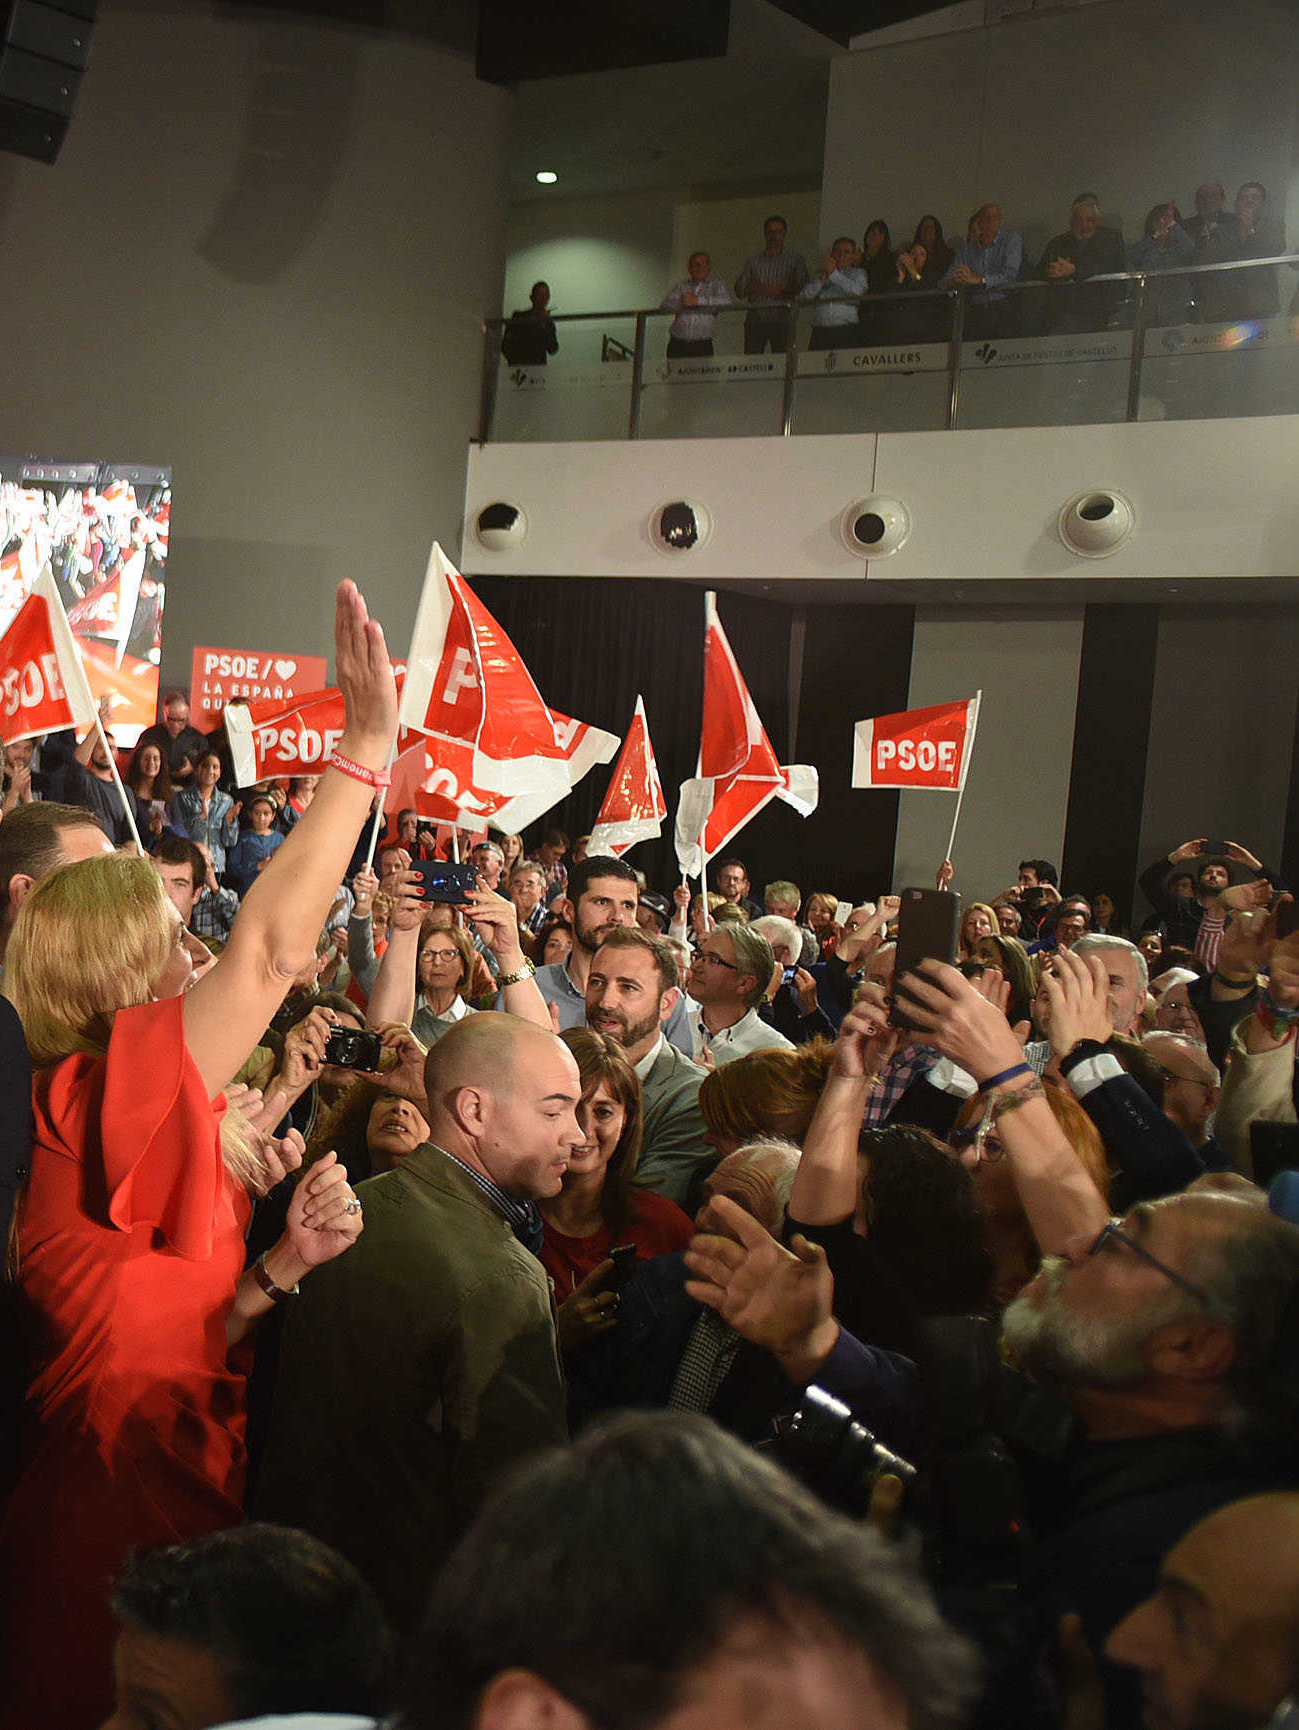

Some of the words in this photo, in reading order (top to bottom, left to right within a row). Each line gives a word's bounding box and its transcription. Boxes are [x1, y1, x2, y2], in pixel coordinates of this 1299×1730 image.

[852, 352, 921, 366] CAVALLERS
[203, 682, 223, 695] LA
[231, 683, 294, 700] ESPAÑA
[260, 727, 344, 763] PSOE
[877, 739, 957, 772] PSOE
